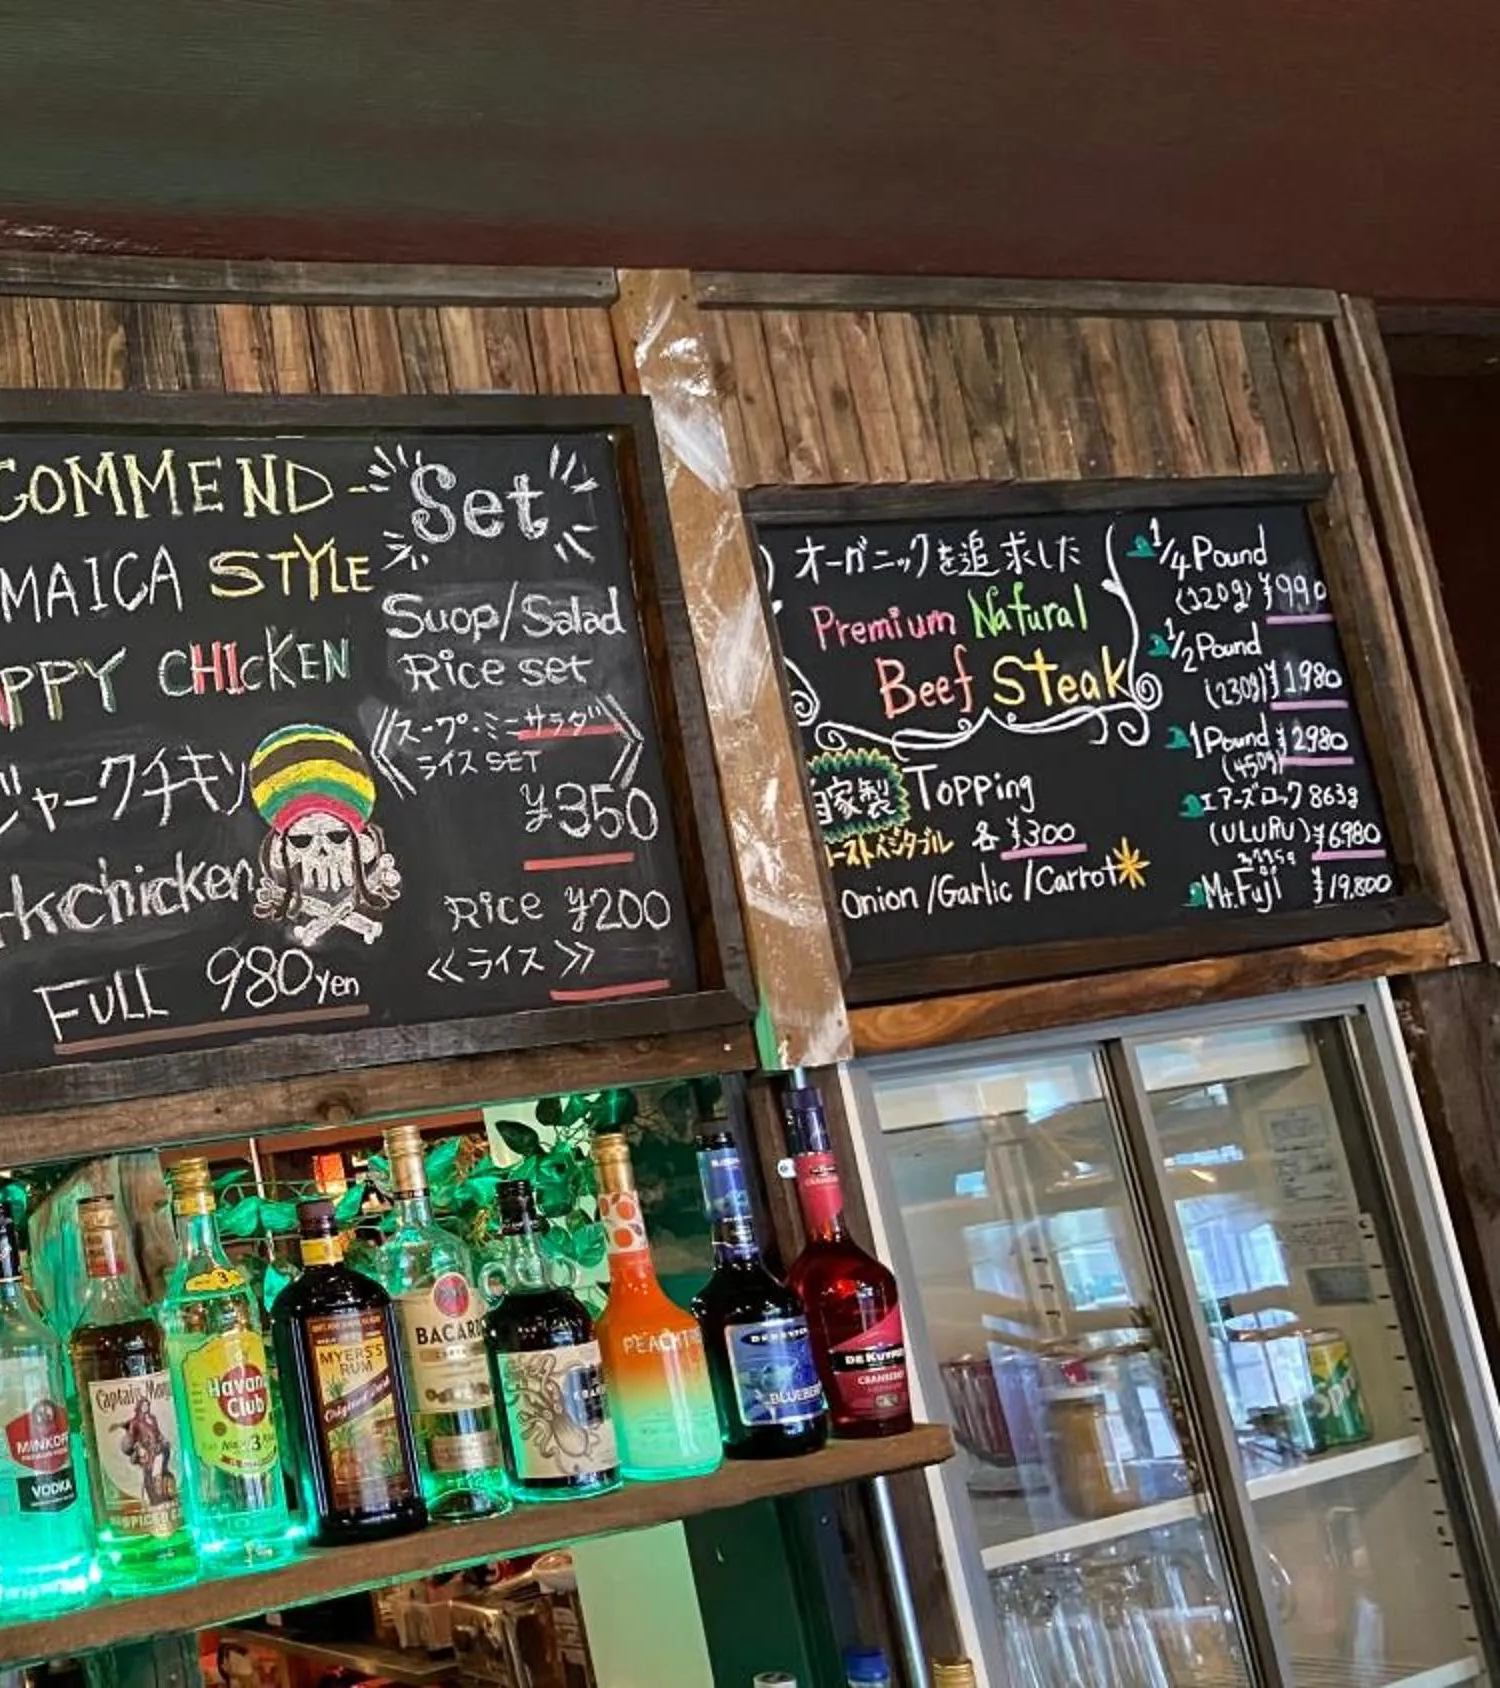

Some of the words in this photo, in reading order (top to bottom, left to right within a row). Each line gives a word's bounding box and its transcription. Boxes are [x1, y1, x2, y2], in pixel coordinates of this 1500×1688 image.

[410, 462, 549, 544] Set
[208, 532, 376, 601] STYLE
[810, 605, 956, 651] Premium
[968, 581, 1088, 639] Natural
[397, 649, 505, 693] Rice
[874, 643, 974, 719] Beef
[992, 645, 1134, 706] Steak
[519, 781, 660, 841] ¥350
[902, 764, 1036, 813] Topping
[444, 890, 546, 931] Rice
[564, 885, 672, 933] ¥200
[841, 881, 920, 919] Onion
[34, 964, 170, 1042] FULL
[227, 1395, 265, 1418] Club
[31, 1479, 73, 1499] VODKA
